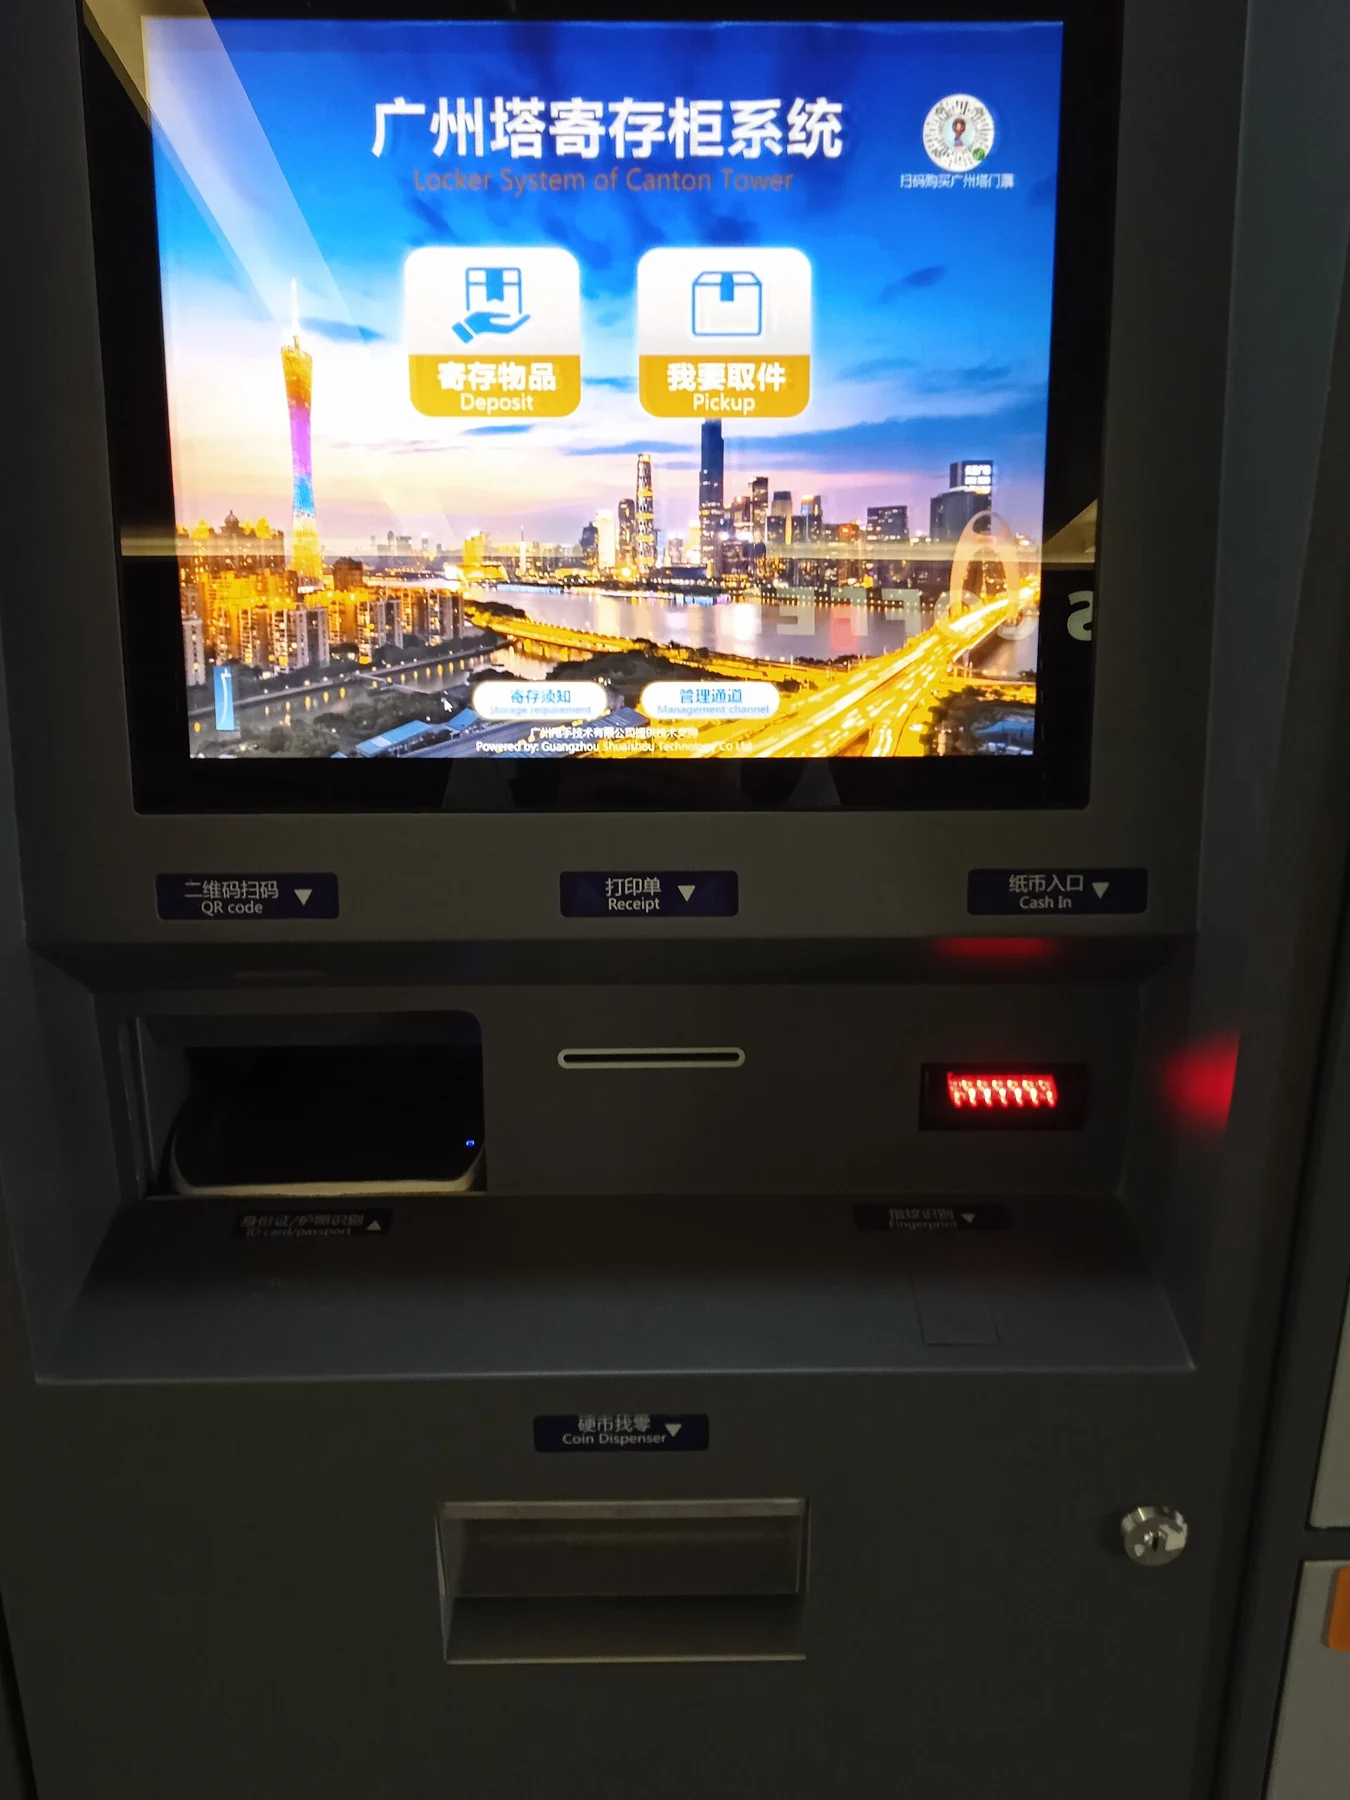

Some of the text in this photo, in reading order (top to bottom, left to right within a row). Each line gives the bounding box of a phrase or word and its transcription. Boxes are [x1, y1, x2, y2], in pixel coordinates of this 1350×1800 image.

[371, 96, 845, 161] 广州塔寄存柜系统
[413, 167, 794, 199] Locker System of Canton Tower
[900, 172, 1015, 189] 扫码购买广州塔门票
[436, 362, 557, 394] 寄存物品
[666, 361, 787, 394] 我要取件
[460, 392, 535, 414] Deposit
[691, 392, 757, 416] Pickup
[510, 689, 572, 704] 寄存须知
[679, 688, 743, 704] 管理通道
[490, 705, 591, 717] Storage requirement
[657, 704, 769, 717] Management channel
[475, 740, 520, 753] Powered
[541, 740, 599, 754] Guangzhou
[184, 880, 279, 900] 二维码扫码
[605, 876, 662, 897] 打印单
[1008, 874, 1084, 893] 纸币入口
[201, 900, 263, 915] QR code
[608, 897, 660, 913] Receipt
[1019, 895, 1072, 909] Cash In
[577, 1413, 651, 1432] 硬币找零
[562, 1431, 667, 1446] Coin Dispenser
